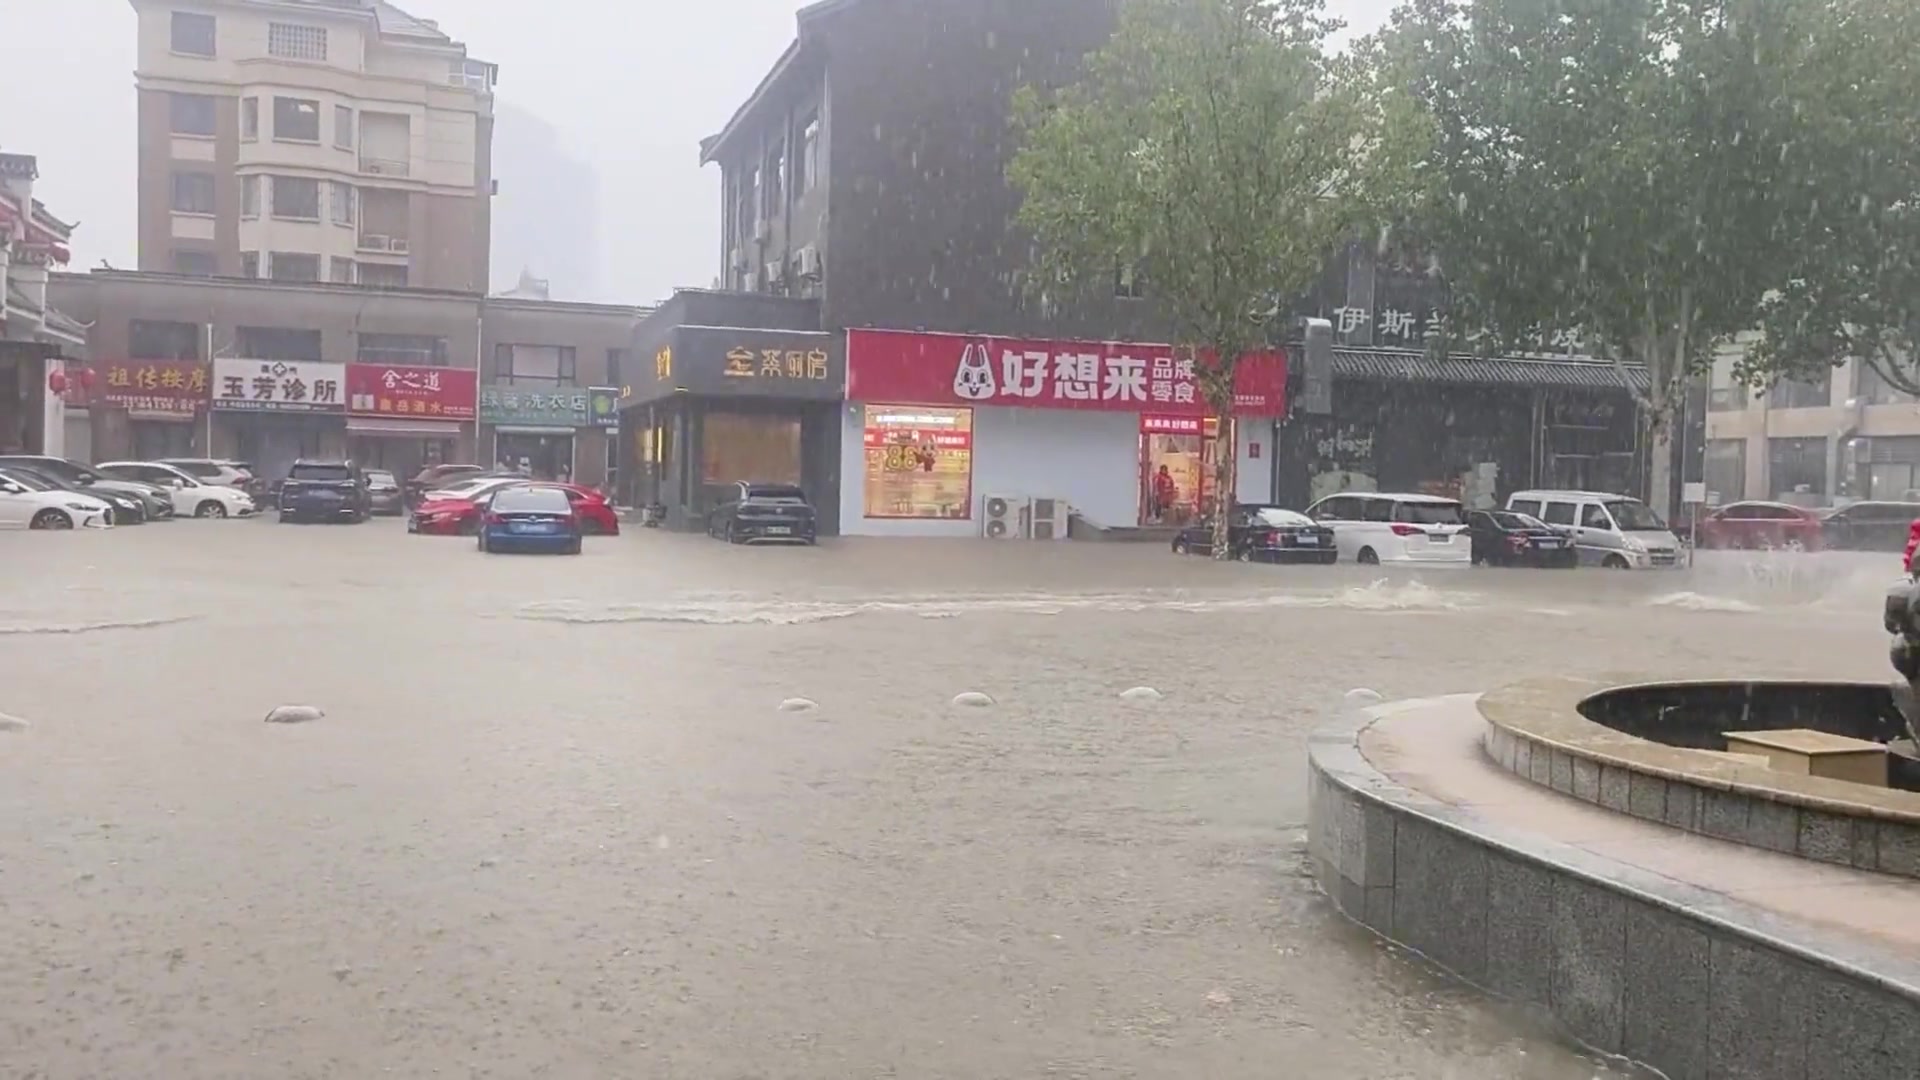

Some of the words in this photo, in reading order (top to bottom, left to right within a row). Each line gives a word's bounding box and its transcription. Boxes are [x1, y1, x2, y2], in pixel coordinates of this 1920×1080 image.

[107, 365, 208, 393] 祖传按摩
[381, 369, 441, 391] 舍之道
[1000, 349, 1147, 402] 好想来
[1152, 356, 1196, 380] 品牌
[221, 376, 337, 402] 玉芳诊所
[1151, 380, 1195, 403] 零食
